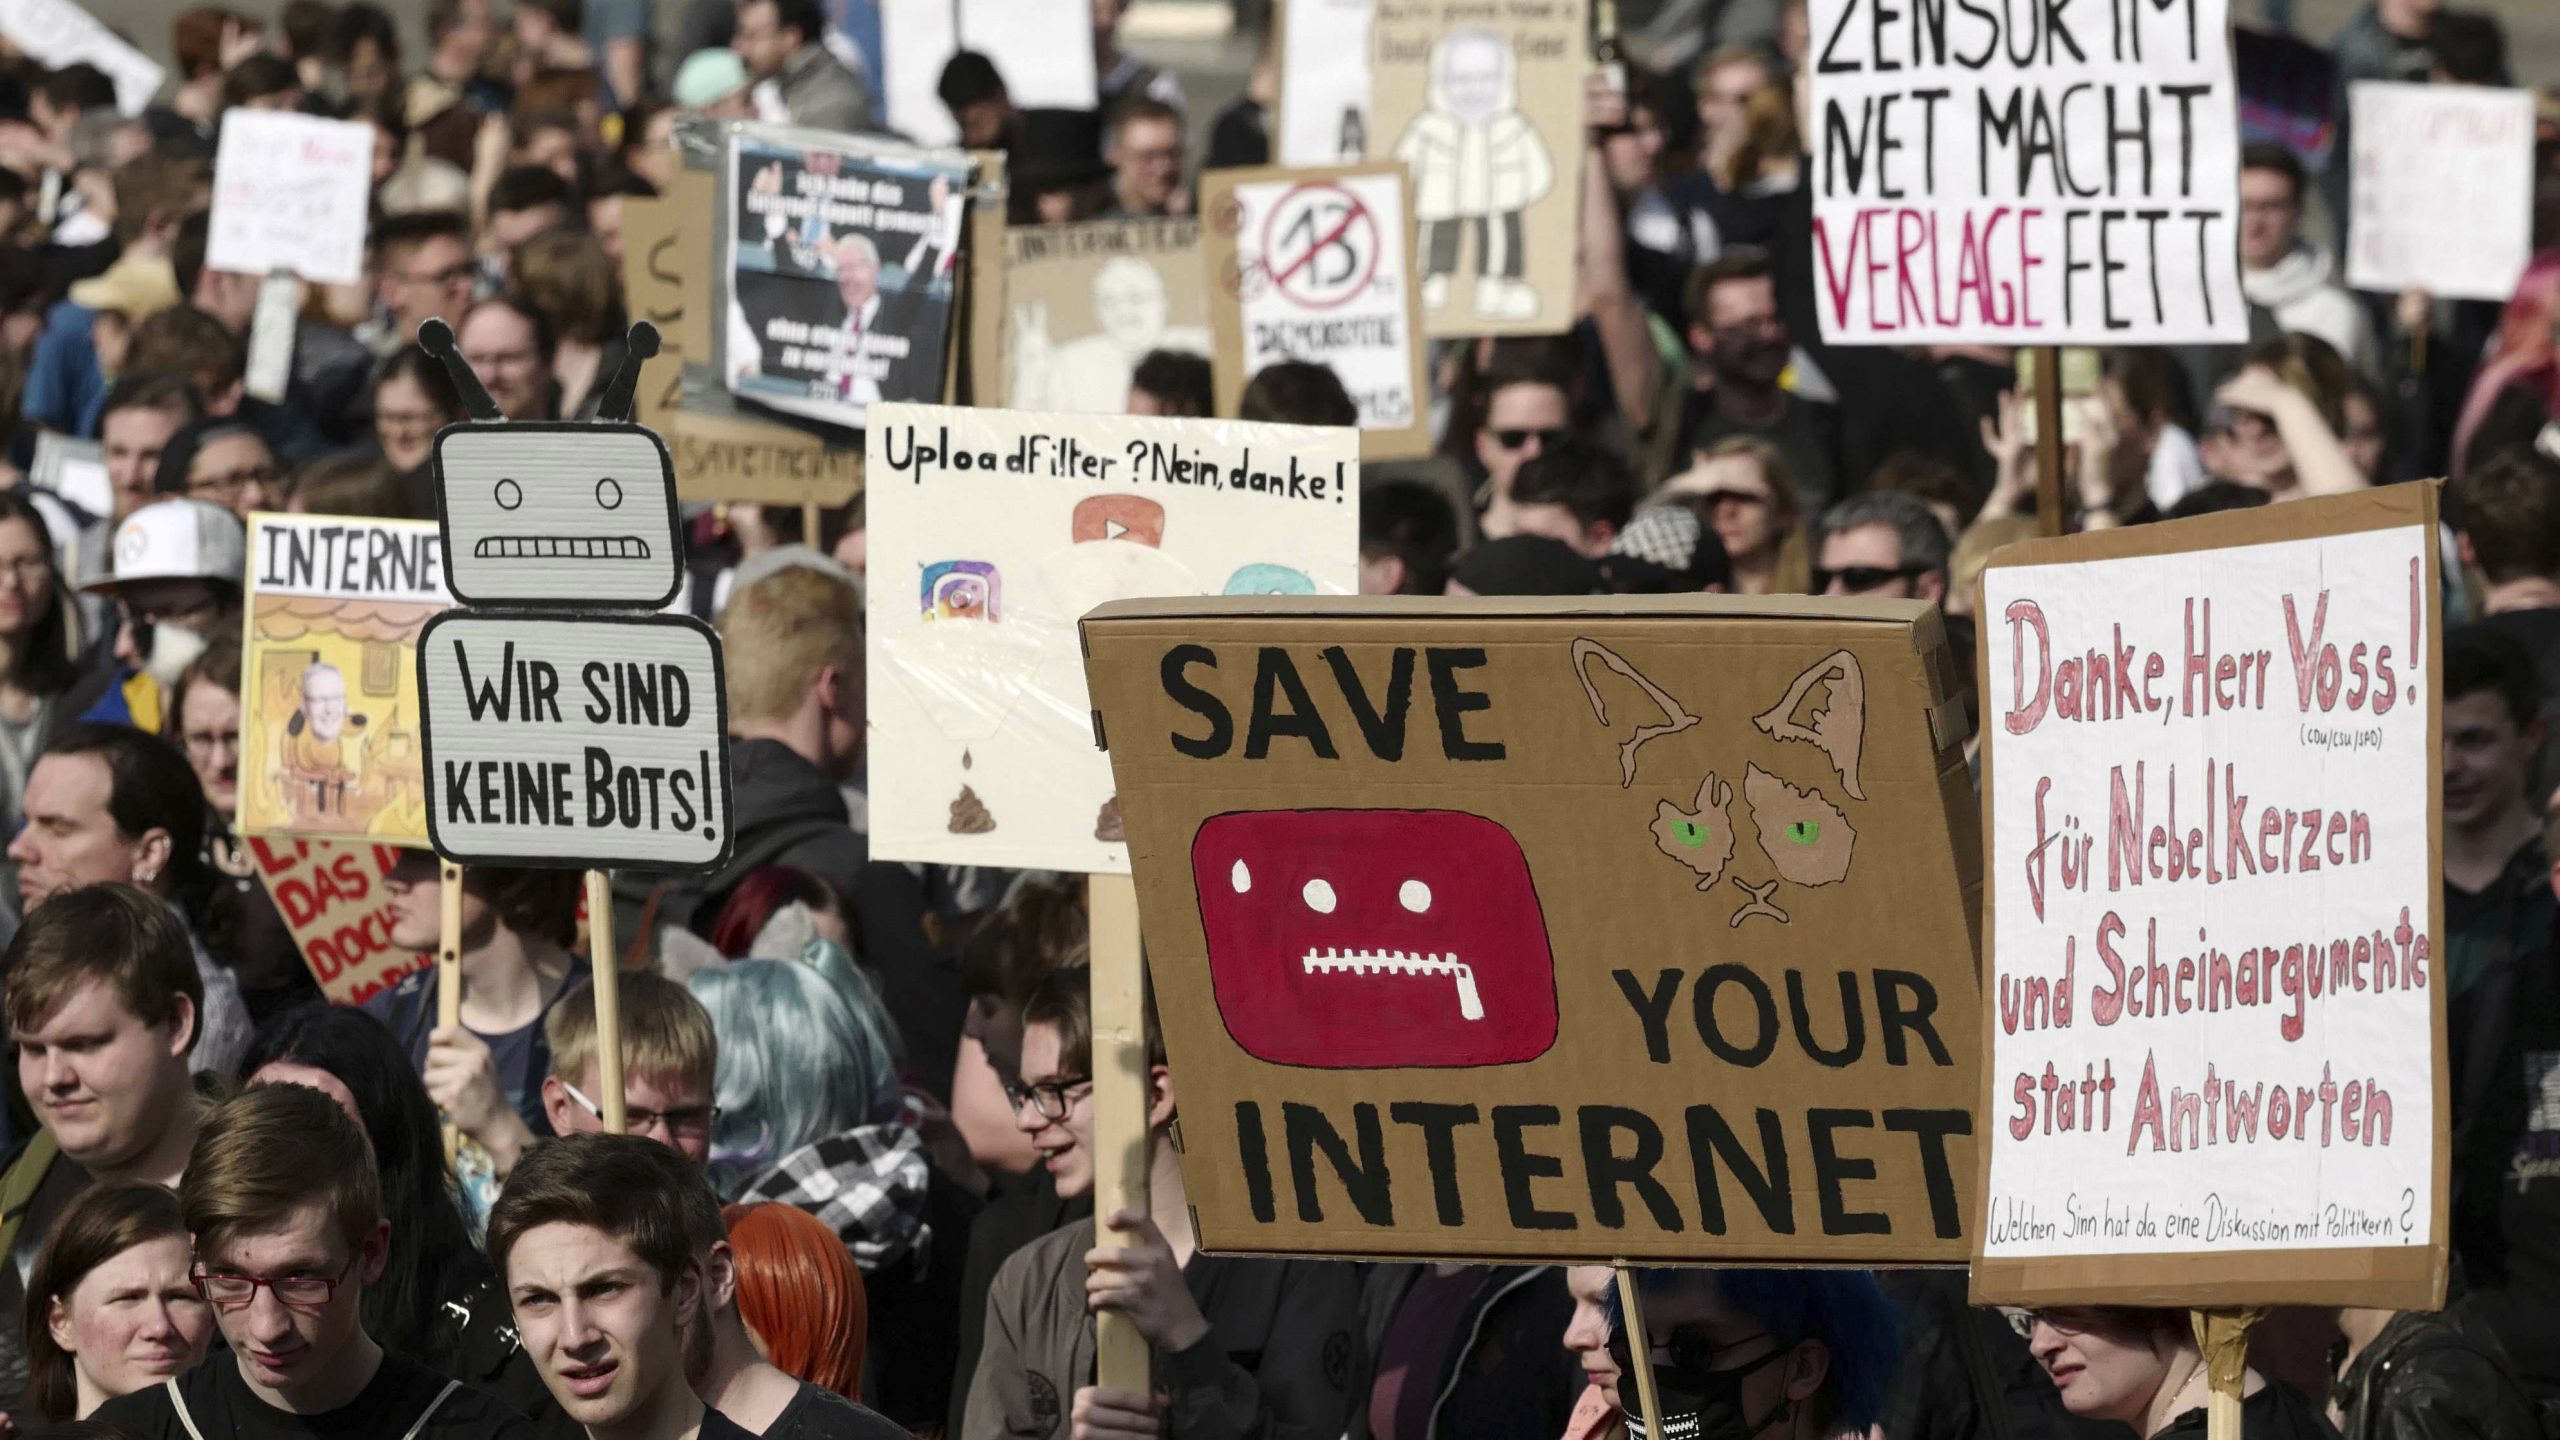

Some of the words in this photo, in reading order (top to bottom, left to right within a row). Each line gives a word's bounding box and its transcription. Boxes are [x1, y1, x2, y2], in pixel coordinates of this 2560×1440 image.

[1824, 88, 1951, 198] NET
[1977, 82, 2212, 198] MACHT
[1812, 206, 2044, 331] VERLAGE
[2064, 209, 2223, 328] FETT
[260, 525, 441, 593] INTERNE
[1159, 643, 1508, 762] SAVE
[2004, 598, 2174, 736] Danke,
[2182, 596, 2272, 718] Herr
[2282, 555, 2421, 716] Voss!
[445, 759, 574, 827] KEINE
[2025, 775, 2094, 925] für
[274, 852, 370, 931] DAS
[1612, 961, 1955, 1068] YOUR
[2000, 934, 2076, 1036] und
[2091, 905, 2431, 1042] Scheinargumente
[2008, 1058, 2117, 1142] statt
[2126, 1047, 2394, 1158] Antworten
[1235, 1099, 1973, 1240] INTERNET
[1989, 1195, 2056, 1246] Welchen
[2063, 1192, 2097, 1239] Sinn
[2104, 1196, 2131, 1238] hat
[2136, 1202, 2157, 1238] da
[2165, 1202, 2200, 1239] eine
[2203, 1192, 2290, 1243] Diskussion
[2294, 1212, 2321, 1239] mit
